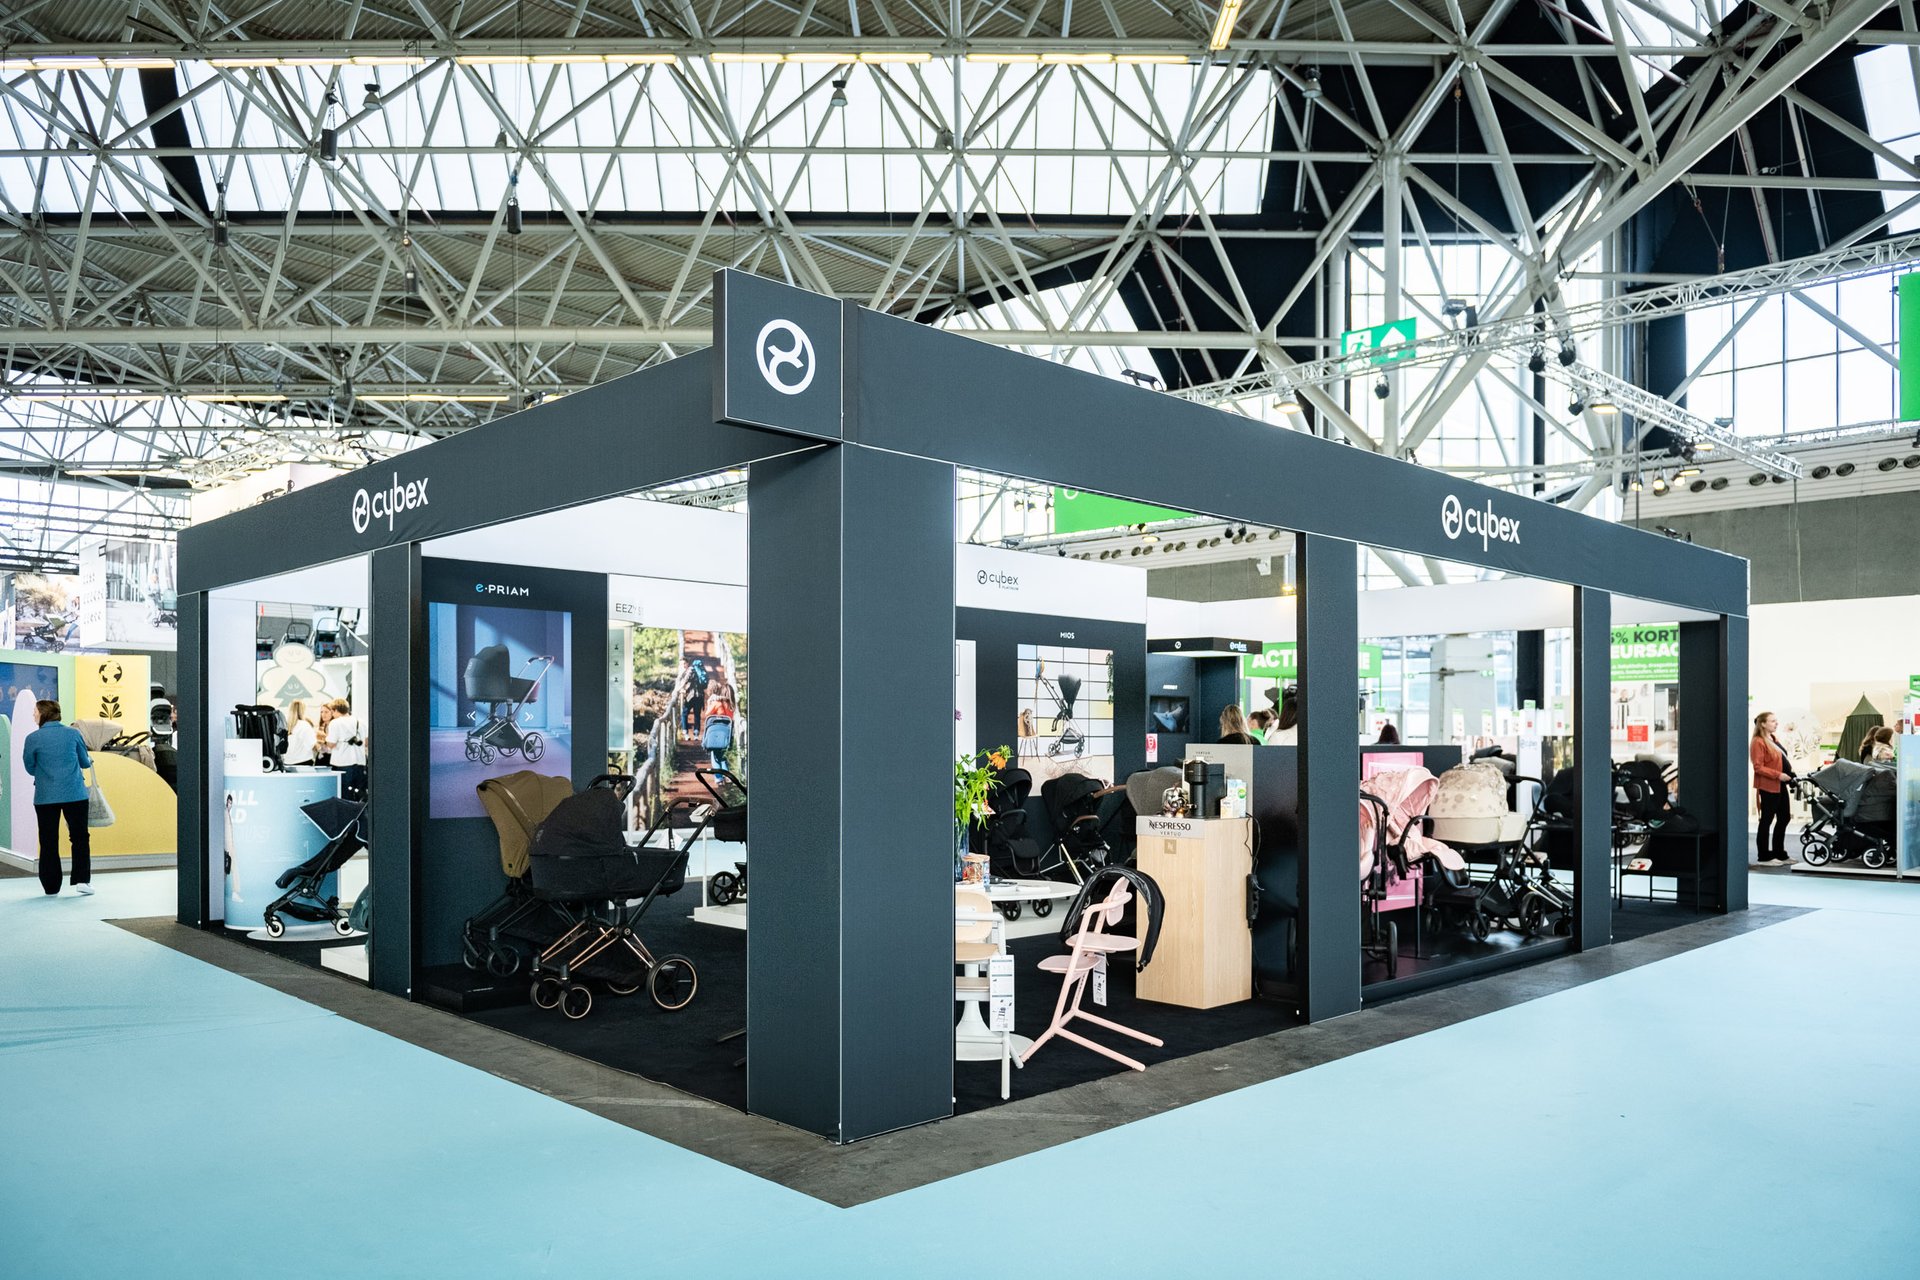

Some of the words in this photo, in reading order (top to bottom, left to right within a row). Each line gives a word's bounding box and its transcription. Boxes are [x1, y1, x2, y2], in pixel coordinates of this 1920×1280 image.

[372, 471, 429, 532] cybex
[1465, 499, 1521, 552] cybex
[989, 570, 1019, 589] cybex
[1149, 819, 1191, 831] NESPRESSO
